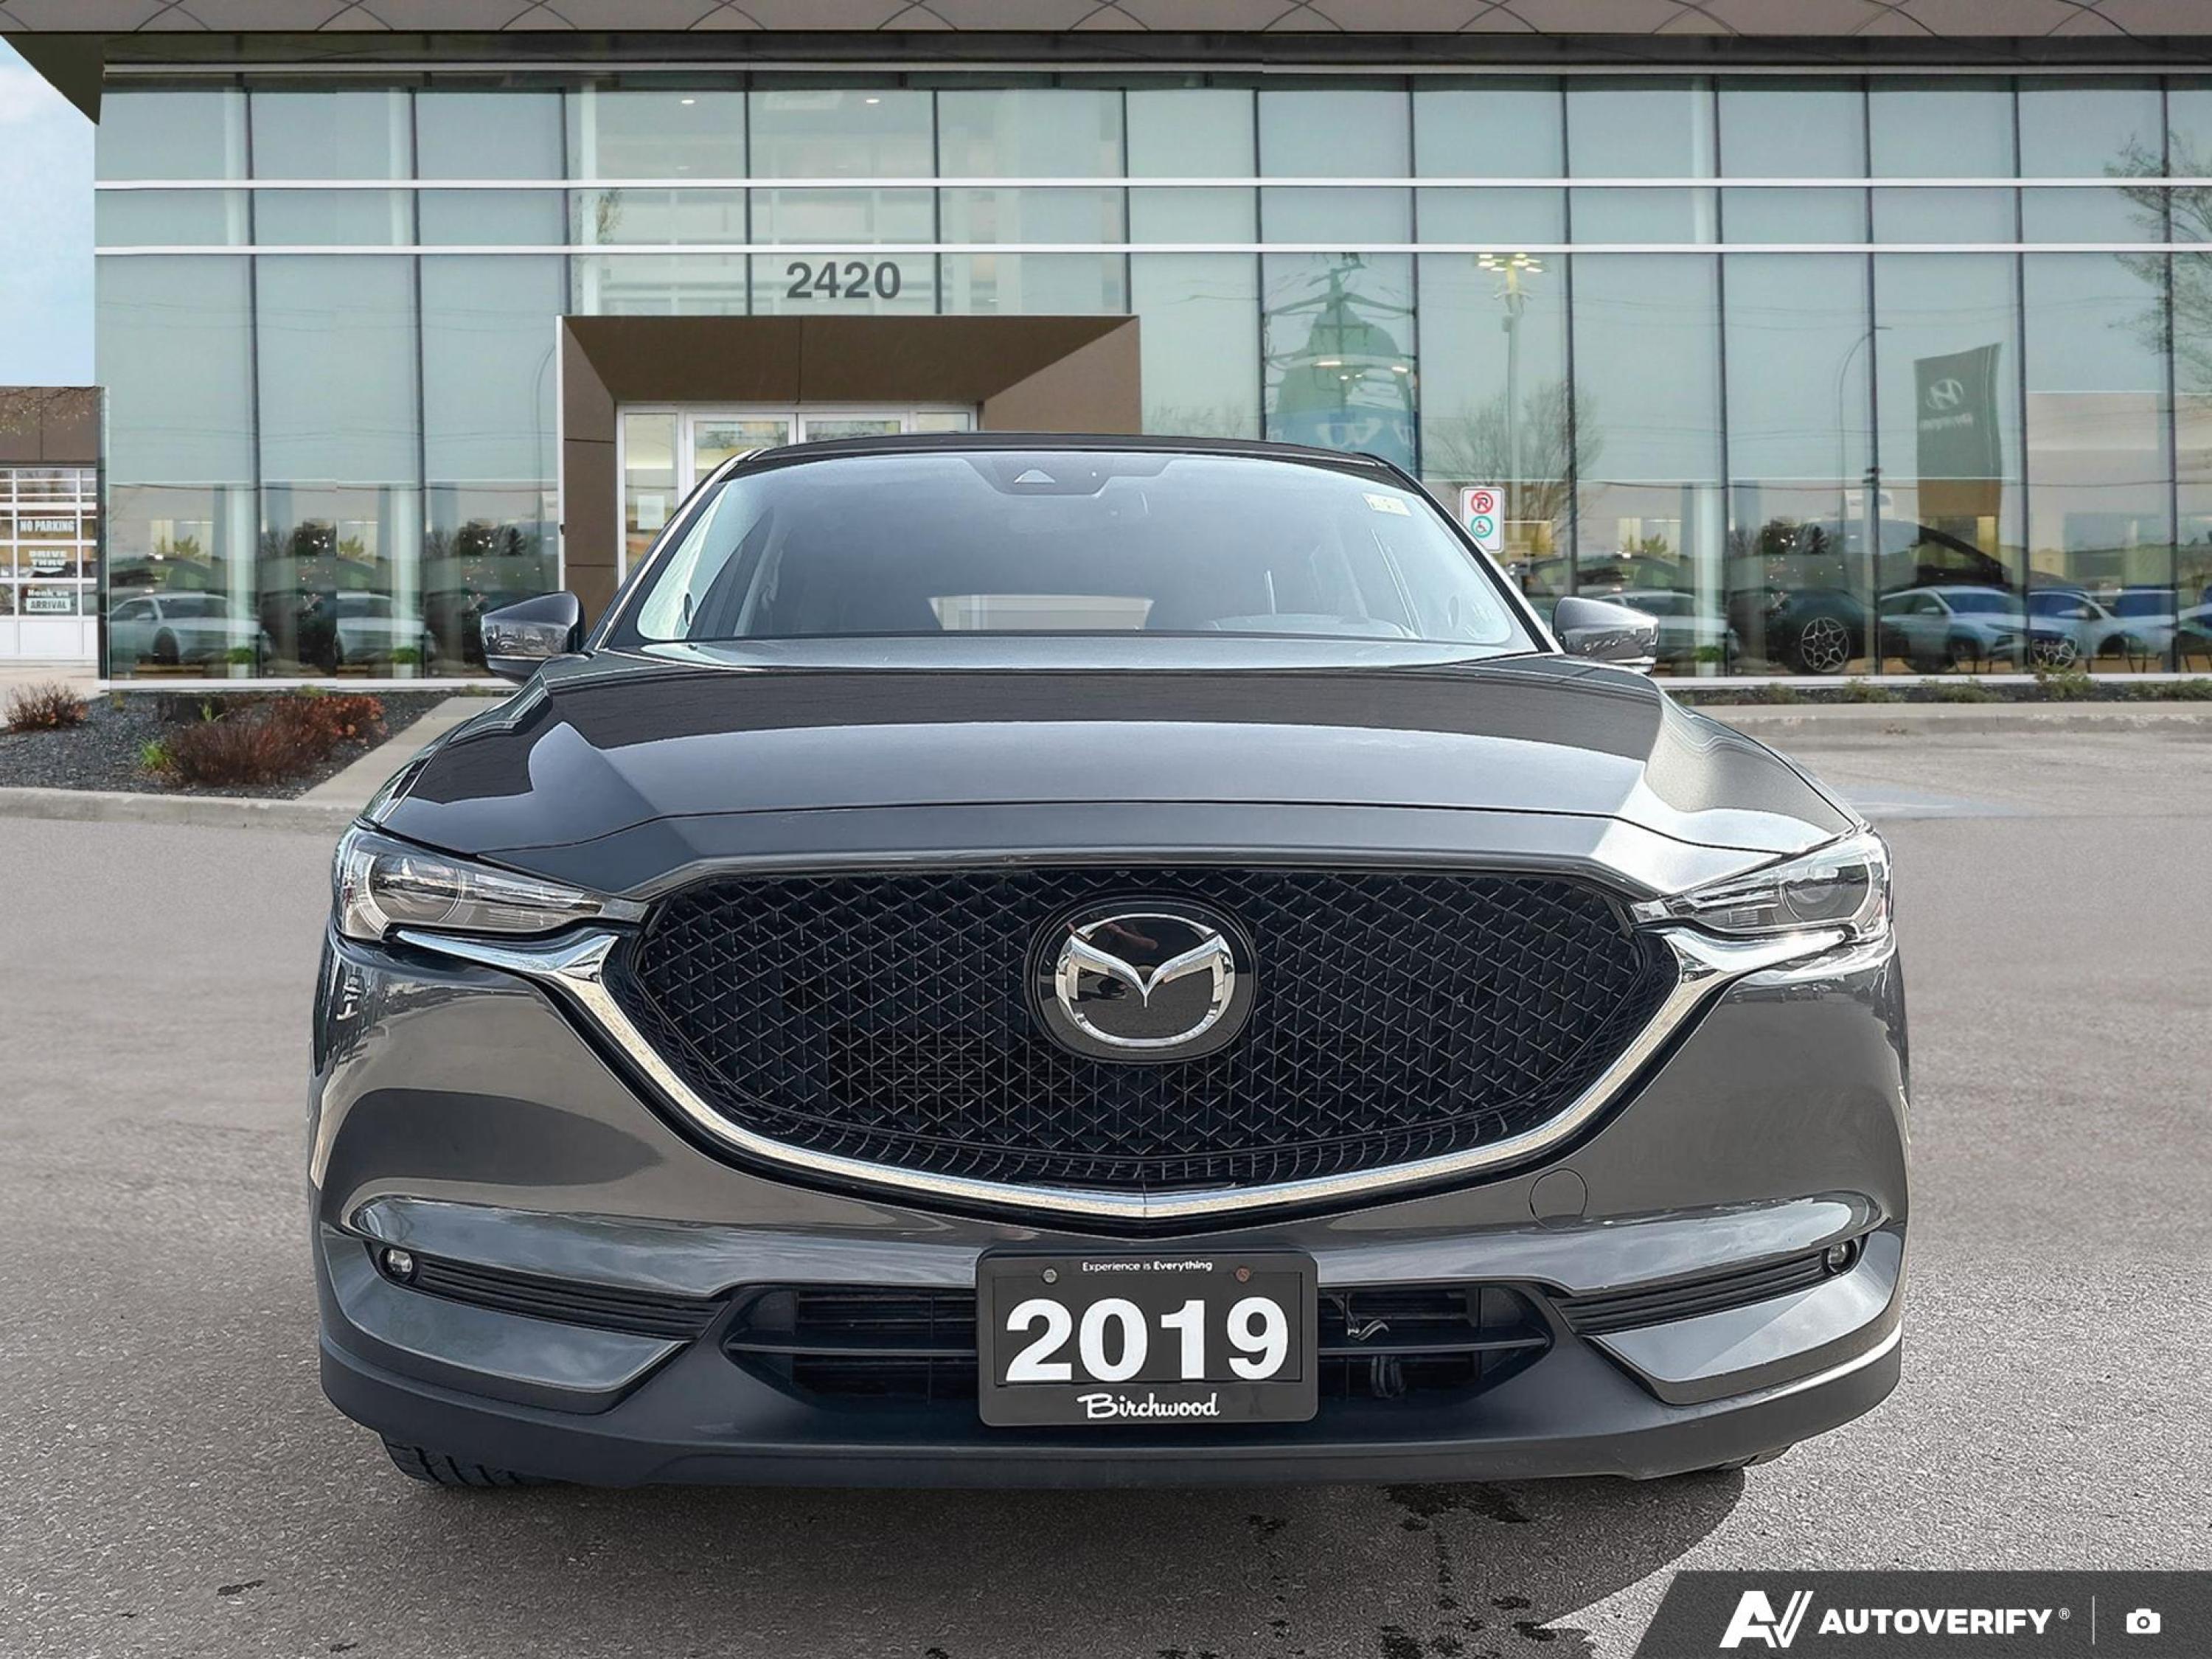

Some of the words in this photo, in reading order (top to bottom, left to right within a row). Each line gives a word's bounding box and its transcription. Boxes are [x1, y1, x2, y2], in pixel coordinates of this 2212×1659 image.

[787, 262, 900, 299] 2420
[20, 521, 33, 532] NO
[35, 521, 74, 532] PARKING
[30, 601, 67, 609] ARRIVAL
[1082, 1262, 1140, 1272] Experience
[1144, 1262, 1151, 1270] is
[1154, 1262, 1213, 1272] Everything
[1006, 1297, 1288, 1382] 2019
[1077, 1393, 1220, 1419] Birchwood
